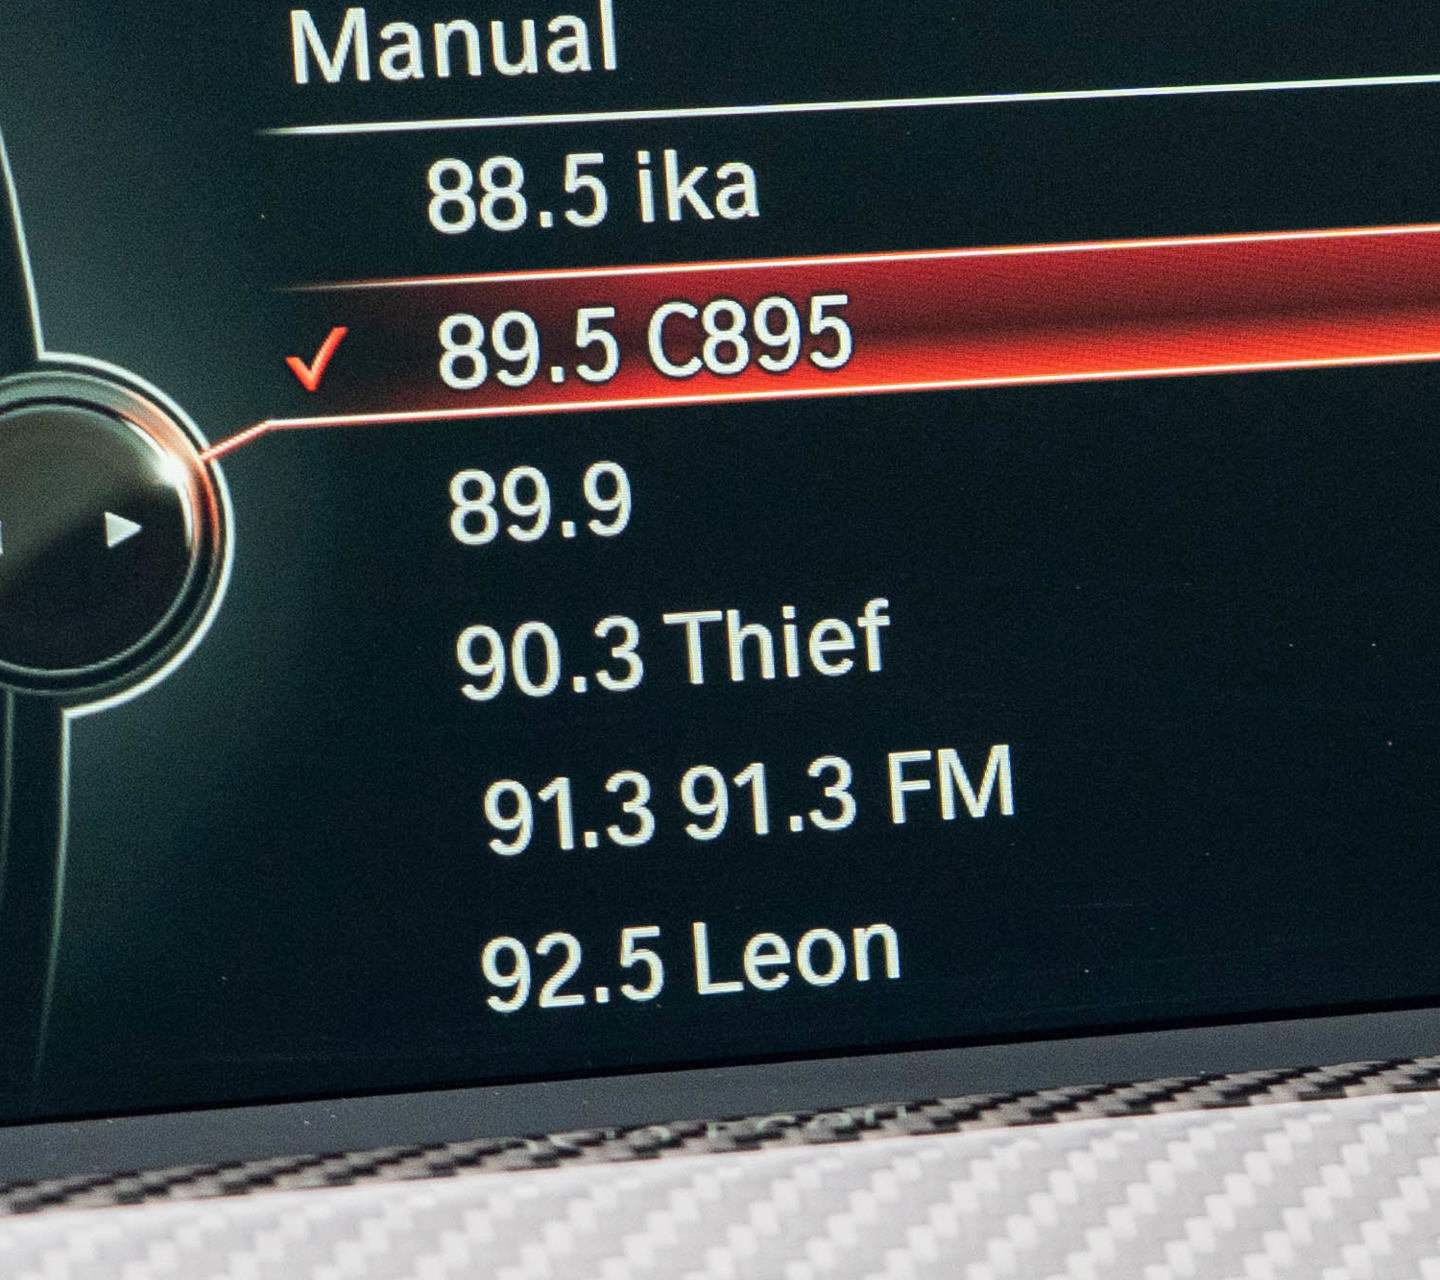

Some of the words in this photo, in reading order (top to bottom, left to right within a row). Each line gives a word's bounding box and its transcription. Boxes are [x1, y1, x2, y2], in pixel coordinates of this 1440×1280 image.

[428, 152, 608, 235] 88.5
[637, 148, 760, 223] ika
[439, 306, 619, 390] 89.5
[648, 293, 852, 378] C895
[450, 460, 632, 546] 89.9
[456, 615, 644, 701] 90.3
[663, 597, 891, 685] Thief
[484, 770, 655, 856] 91.3
[681, 755, 857, 841] 91.3
[888, 744, 1014, 825] FM
[482, 925, 664, 1013] 92.5
[693, 921, 900, 995] Leon
